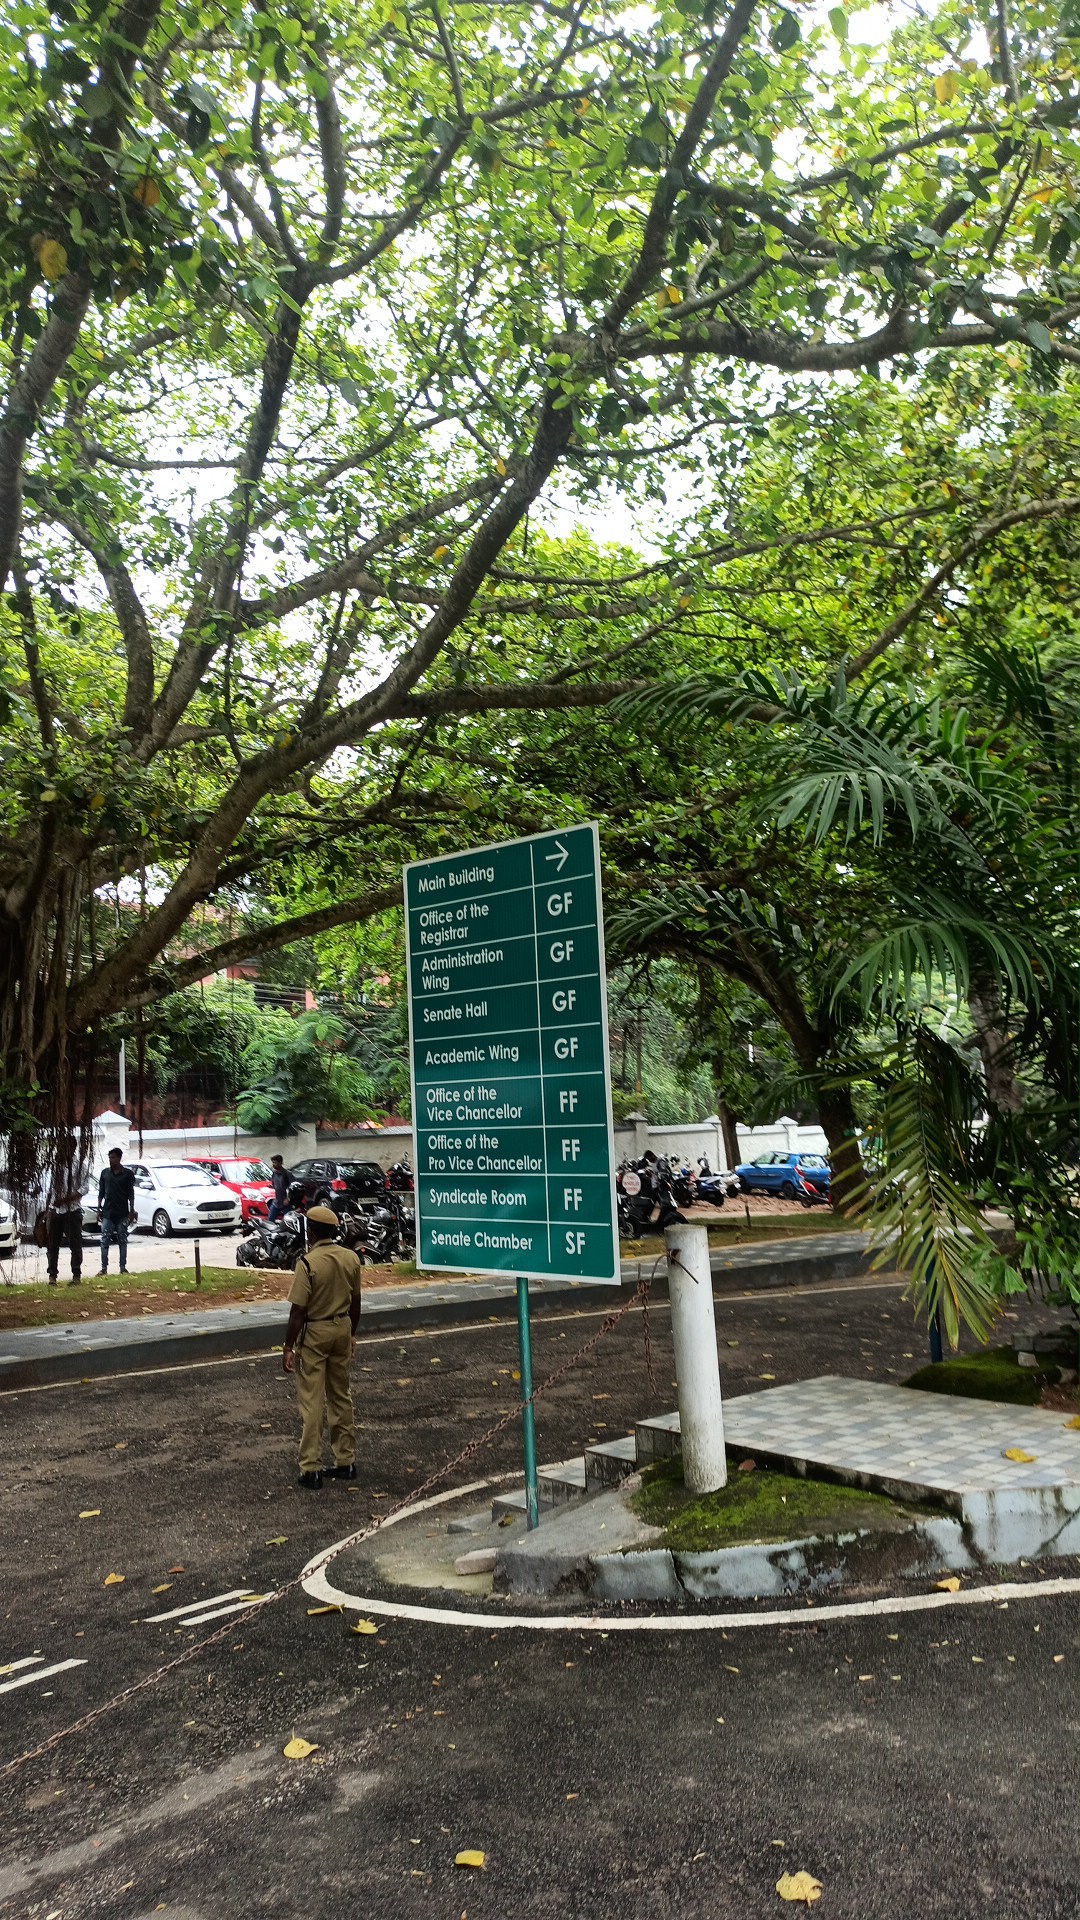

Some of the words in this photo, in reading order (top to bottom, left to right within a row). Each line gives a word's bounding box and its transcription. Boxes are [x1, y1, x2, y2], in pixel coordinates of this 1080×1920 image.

[419, 875, 445, 893] Main
[449, 867, 494, 886] Building
[546, 892, 573, 916] GF
[419, 909, 453, 928] Office
[456, 904, 468, 921] of
[470, 902, 489, 918] the
[420, 926, 469, 946] Registrar
[422, 948, 504, 973] Administration
[549, 940, 574, 962] GF
[422, 975, 450, 991] Wing
[551, 990, 577, 1011] GF
[424, 1005, 462, 1022] Senate
[466, 1001, 487, 1017] Hall
[426, 1047, 485, 1065] Academic
[489, 1045, 518, 1062] Wing
[554, 1037, 579, 1059] GF
[427, 1087, 461, 1103] Office
[464, 1086, 475, 1101] of
[478, 1086, 496, 1100] the
[560, 1091, 577, 1112] FF
[427, 1107, 452, 1121] Vice
[456, 1103, 522, 1120] Chancellor
[428, 1135, 462, 1149] Office
[466, 1134, 476, 1149] of
[480, 1134, 498, 1148] the
[562, 1139, 580, 1161] FF
[429, 1157, 445, 1170] Pro
[449, 1156, 473, 1170] Vice
[477, 1155, 542, 1170] Chancellor
[430, 1189, 487, 1206] Syndicate
[492, 1190, 526, 1205] Room
[564, 1189, 582, 1210] FF
[432, 1230, 471, 1246] Senate
[475, 1232, 532, 1250] Chamber
[566, 1232, 585, 1254] SF
